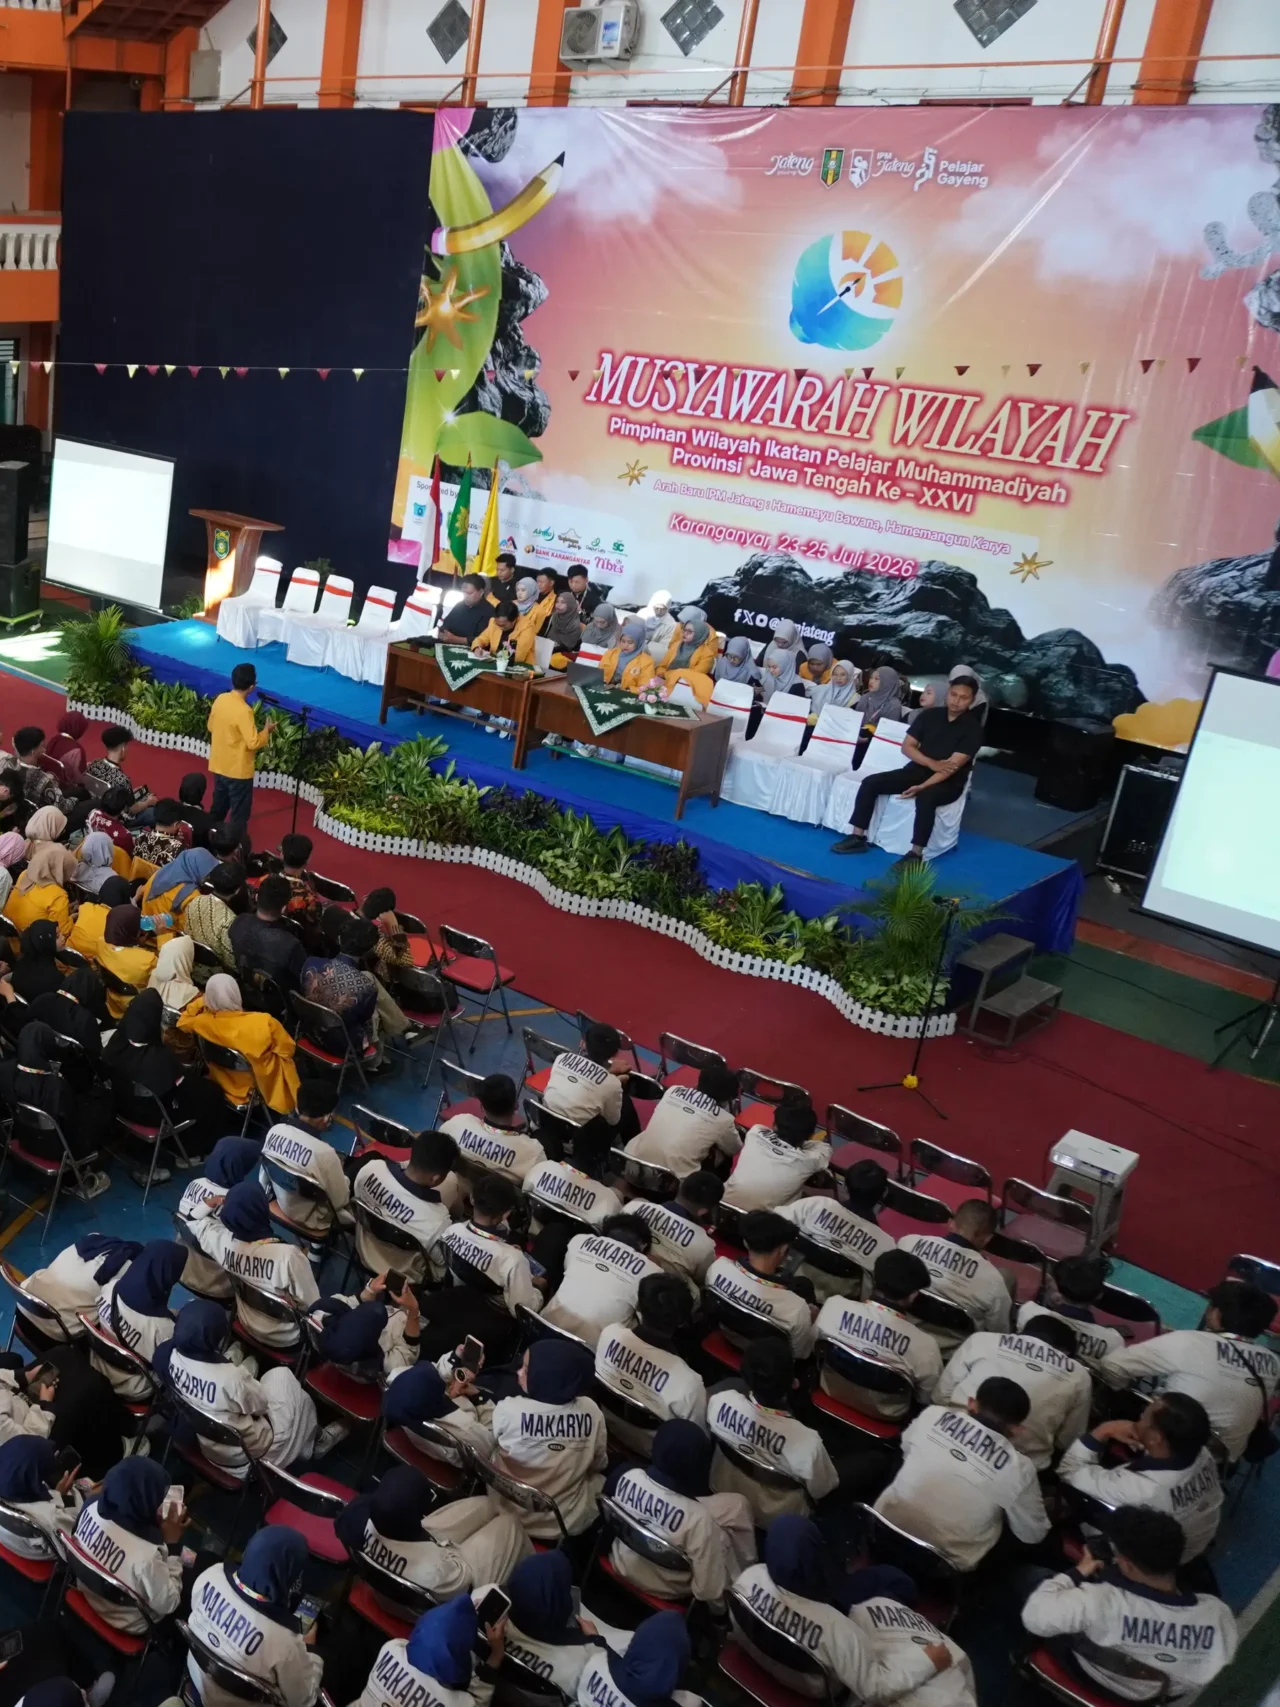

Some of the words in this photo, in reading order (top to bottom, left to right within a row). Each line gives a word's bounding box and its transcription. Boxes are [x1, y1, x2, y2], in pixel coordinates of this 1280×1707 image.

[764, 152, 814, 176] Jateng
[872, 158, 915, 177] Jateng
[877, 152, 892, 160] IPM
[939, 160, 985, 175] Pelajar
[937, 173, 988, 188] Gayeng
[586, 352, 889, 440] MUSYAWARAH
[892, 387, 1131, 473] WILAYAH
[609, 416, 686, 443] Pimpinan
[691, 429, 761, 457] Wilayah
[765, 440, 821, 465] Ikatan
[826, 449, 892, 476] Pelajar
[895, 459, 1067, 503] Muhammadiyah
[672, 447, 742, 473] Provinsi
[750, 460, 798, 483] Jawa
[803, 468, 871, 497] Tengah
[875, 479, 901, 500] Ke
[919, 486, 973, 512] XXVI
[417, 481, 448, 495] Sponed
[654, 479, 678, 493] Arah
[680, 483, 704, 497] Baru
[706, 488, 727, 501] IPM
[727, 492, 765, 510] Jateng
[771, 500, 833, 522] Hamemayu
[835, 510, 883, 533] Bawana,
[885, 520, 970, 547] Hamemangun
[972, 536, 1011, 555] Karya
[535, 548, 550, 557] BANK
[551, 551, 591, 565] KARANGANYAR
[670, 514, 772, 550] Karanganyar,
[778, 535, 829, 559] 23-25
[832, 546, 865, 567] Juli
[866, 552, 915, 577] 2026
[769, 617, 836, 646] @jateng
[559, 1052, 609, 1086] MAKARYO
[459, 1128, 516, 1168] MAKARYO
[363, 1173, 416, 1225] MAKARYO
[536, 1171, 596, 1211] MAKARYO
[634, 1203, 695, 1248] MAKARYO
[814, 1208, 878, 1257] MAKARYO
[222, 1247, 275, 1280] MAKARYO
[580, 1236, 646, 1276] MAKARYO
[911, 1238, 979, 1279] MAKARYO
[839, 1310, 911, 1356] MAKARYO
[605, 1338, 670, 1393] MAKARYO
[520, 1412, 592, 1438] MAKARYO
[717, 1402, 786, 1455] MAKARYO
[935, 1411, 1011, 1471] MAKARYO
[617, 1476, 685, 1533] MAKARYO
[76, 1509, 126, 1574] MAKARYO
[202, 1581, 265, 1656] MAKARYO
[747, 1583, 824, 1651] MAKARYO
[1121, 1615, 1215, 1650] MAKARYO
